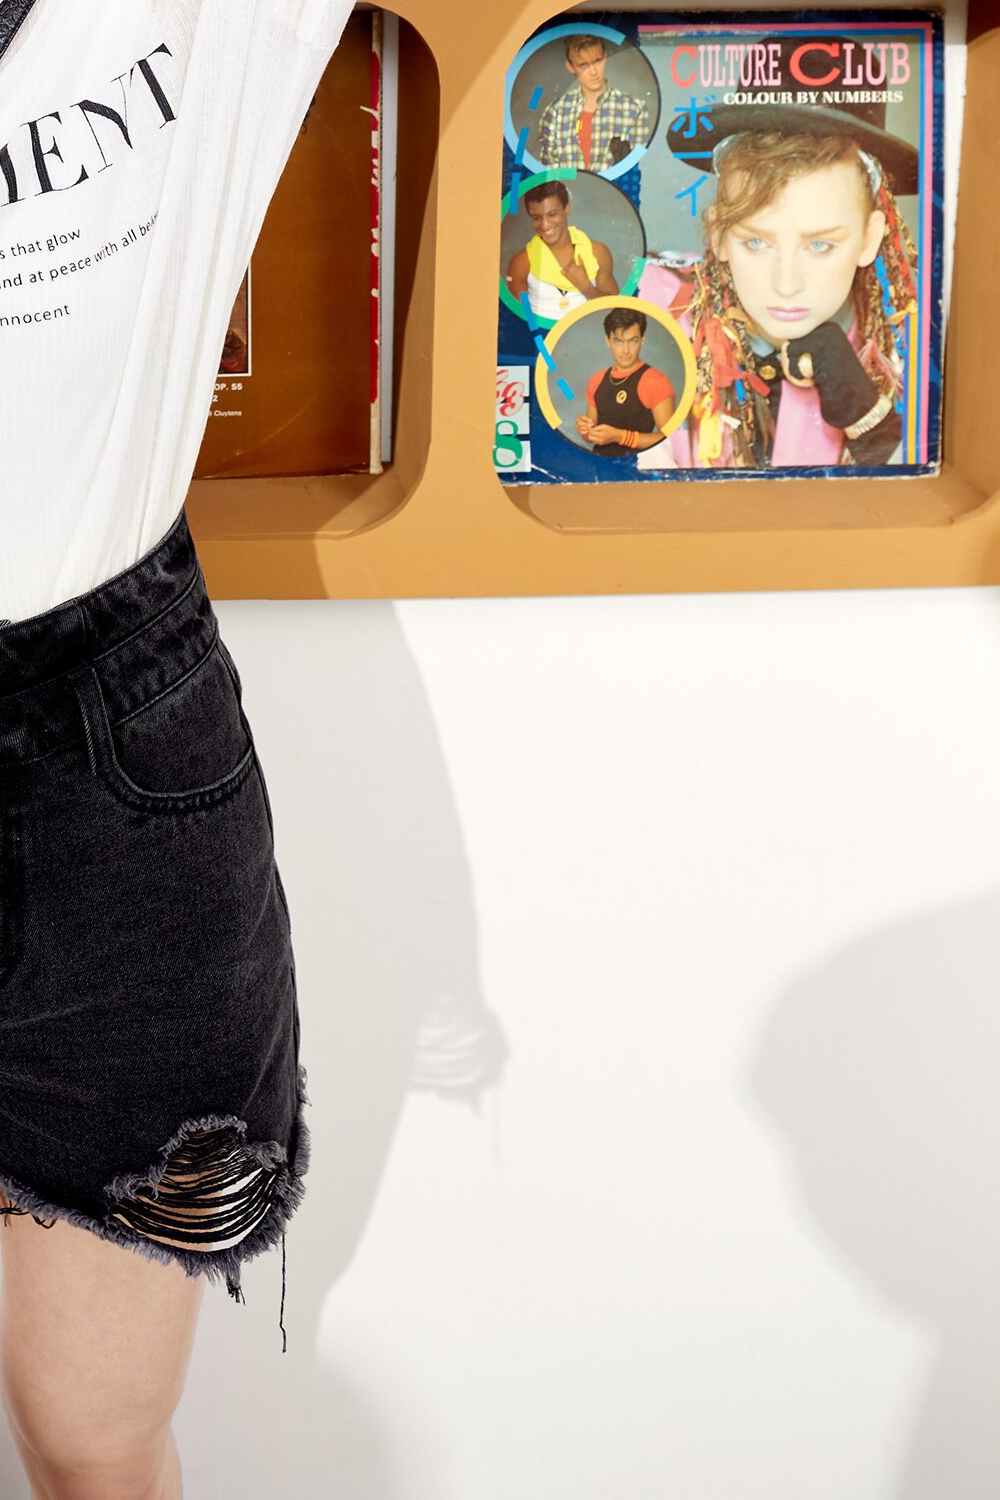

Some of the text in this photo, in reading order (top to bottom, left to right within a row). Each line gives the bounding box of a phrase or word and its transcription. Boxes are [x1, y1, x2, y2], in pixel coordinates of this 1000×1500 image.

[671, 42, 911, 88] CULTURE CLUB
[723, 89, 904, 106] COLOUR BY NUMBERS
[11, 240, 43, 257] that
[47, 228, 81, 252] glow
[29, 270, 44, 284] at
[49, 257, 93, 282] peace
[94, 242, 119, 264] with
[121, 228, 138, 248] all
